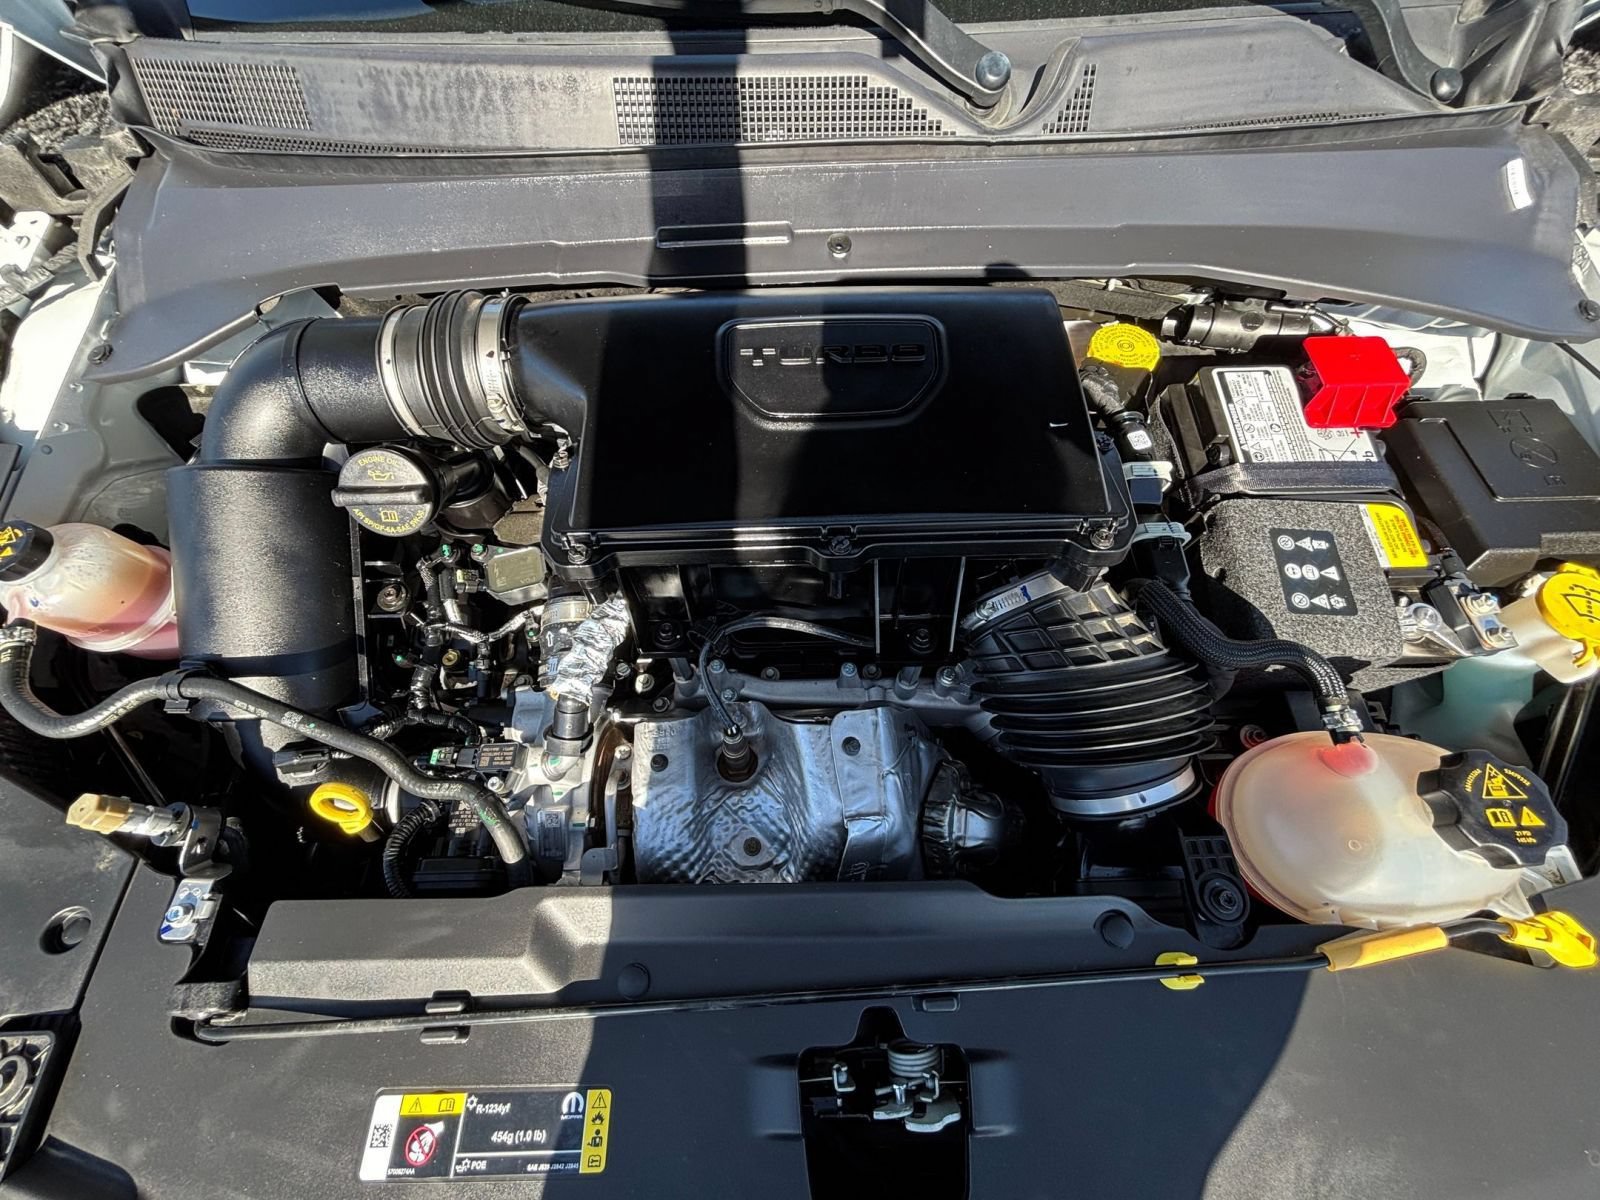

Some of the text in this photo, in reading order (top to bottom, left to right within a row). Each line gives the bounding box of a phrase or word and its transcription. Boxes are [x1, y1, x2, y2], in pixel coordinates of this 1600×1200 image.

[358, 455, 400, 468] ENGINE OIL
[352, 508, 364, 520] API
[475, 1102, 511, 1116] R-1234yf
[491, 1129, 547, 1144] 454g (1.0 lb)
[471, 1160, 487, 1170] POE
